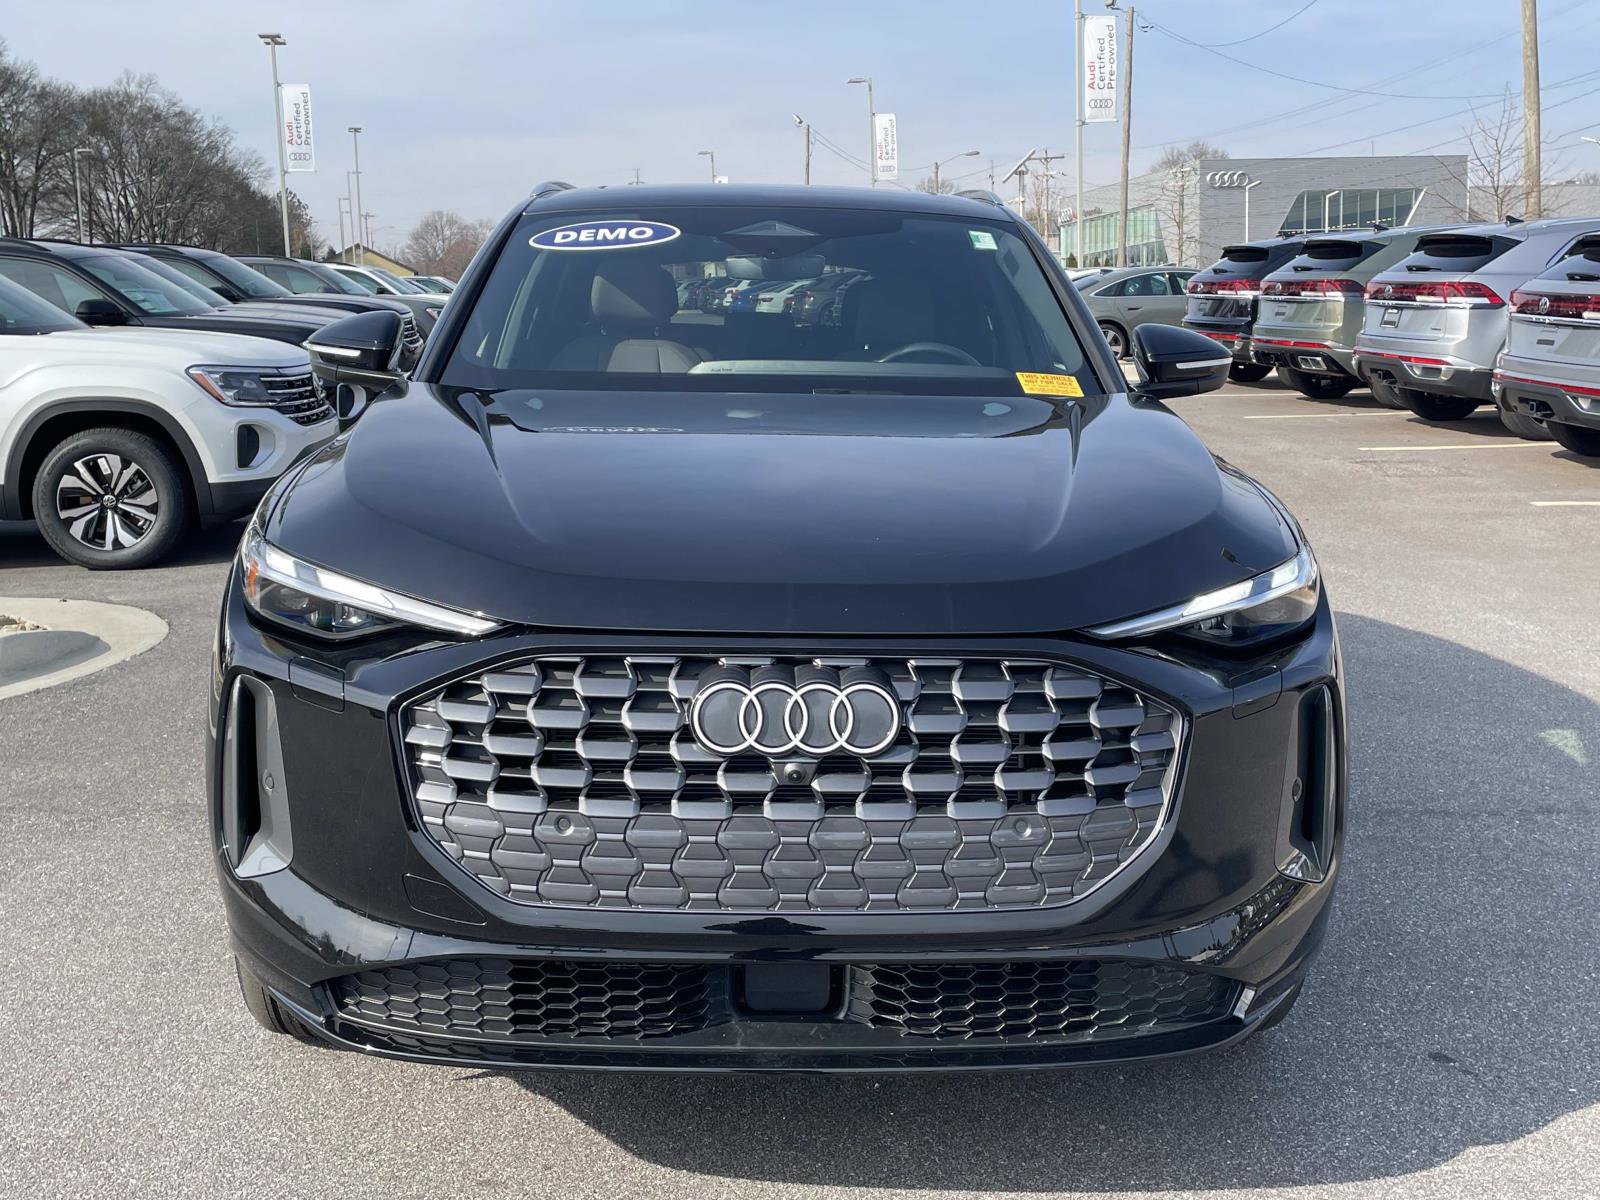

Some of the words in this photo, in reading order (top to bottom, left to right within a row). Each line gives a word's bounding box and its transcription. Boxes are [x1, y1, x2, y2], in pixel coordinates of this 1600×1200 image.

[1088, 61, 1096, 90] Audi
[1097, 38, 1106, 90] Certified
[1106, 24, 1115, 90] Pre-owned
[286, 122, 295, 145] Audi
[293, 103, 303, 146] Certified
[300, 92, 311, 146] Pre-owned
[553, 227, 654, 243] DEMO
